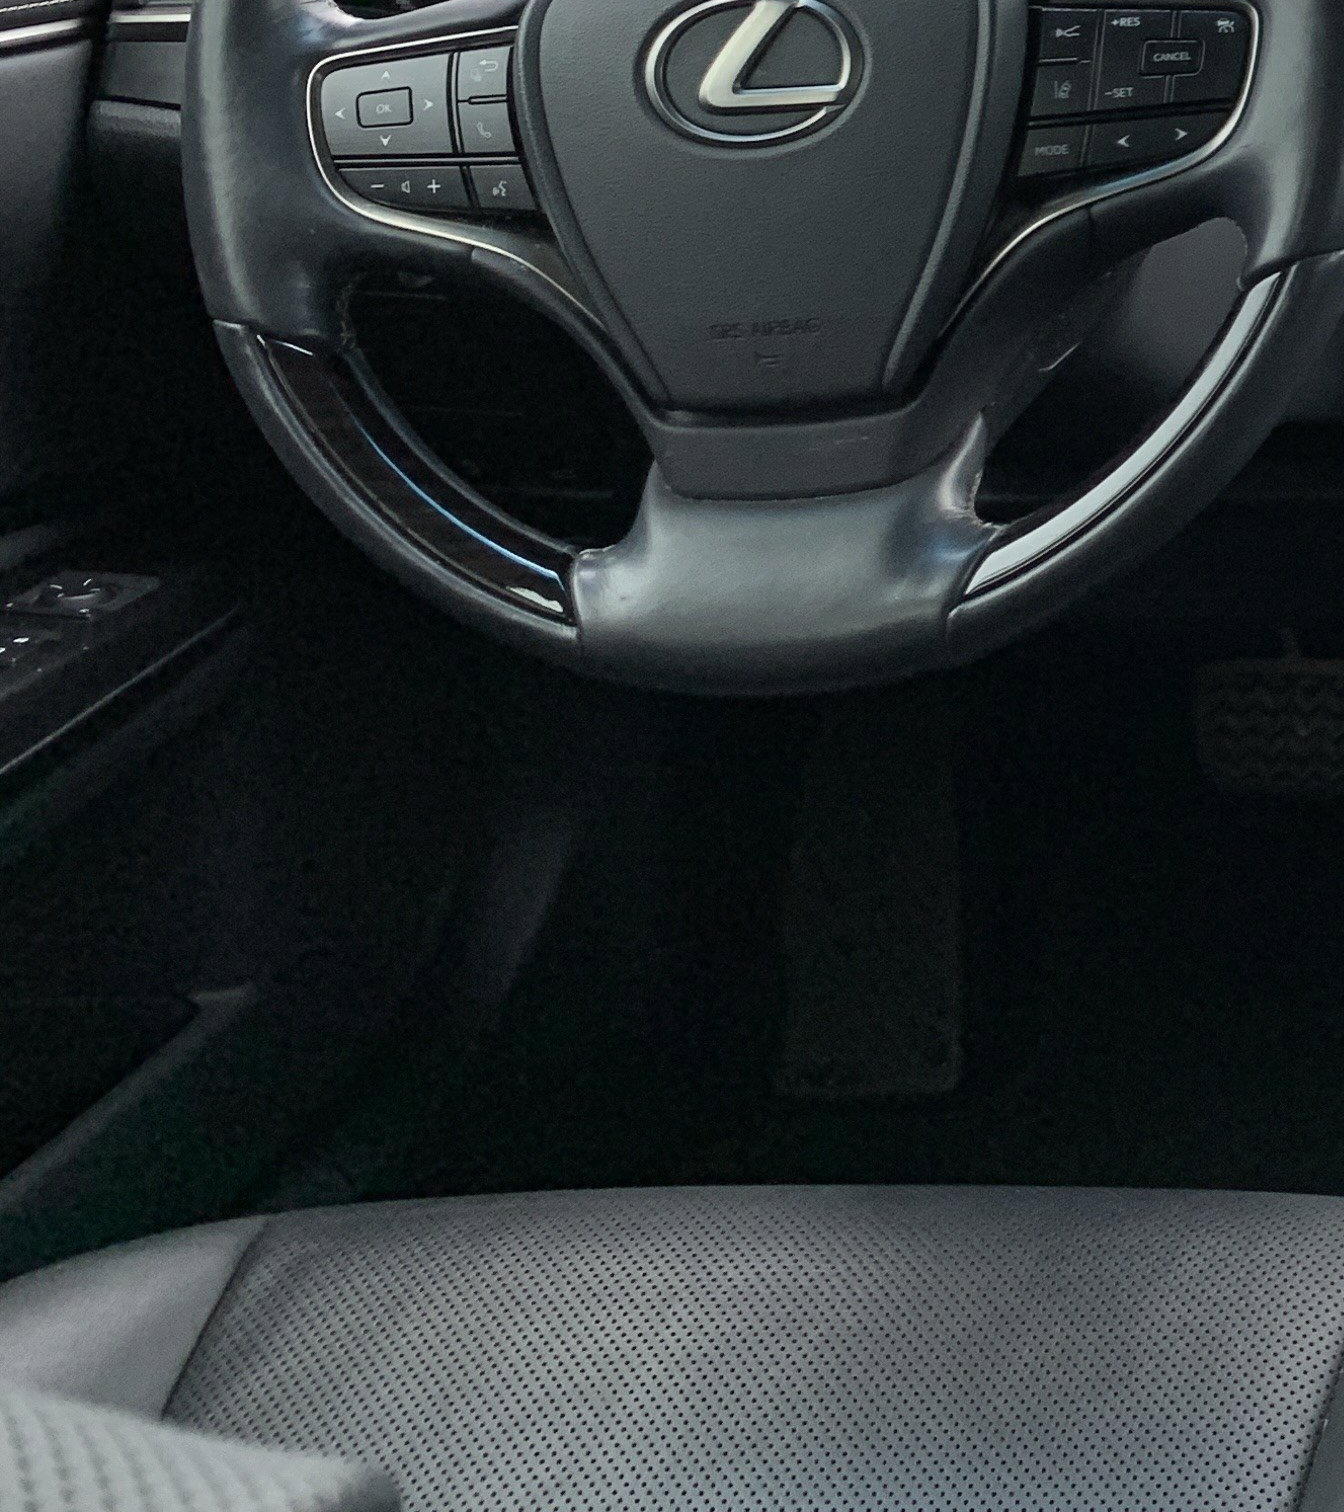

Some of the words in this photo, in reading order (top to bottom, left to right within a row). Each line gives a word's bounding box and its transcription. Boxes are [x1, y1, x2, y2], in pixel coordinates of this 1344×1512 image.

[1152, 50, 1192, 64] CANCEL
[375, 102, 393, 115] OK
[1034, 144, 1070, 156] MODE
